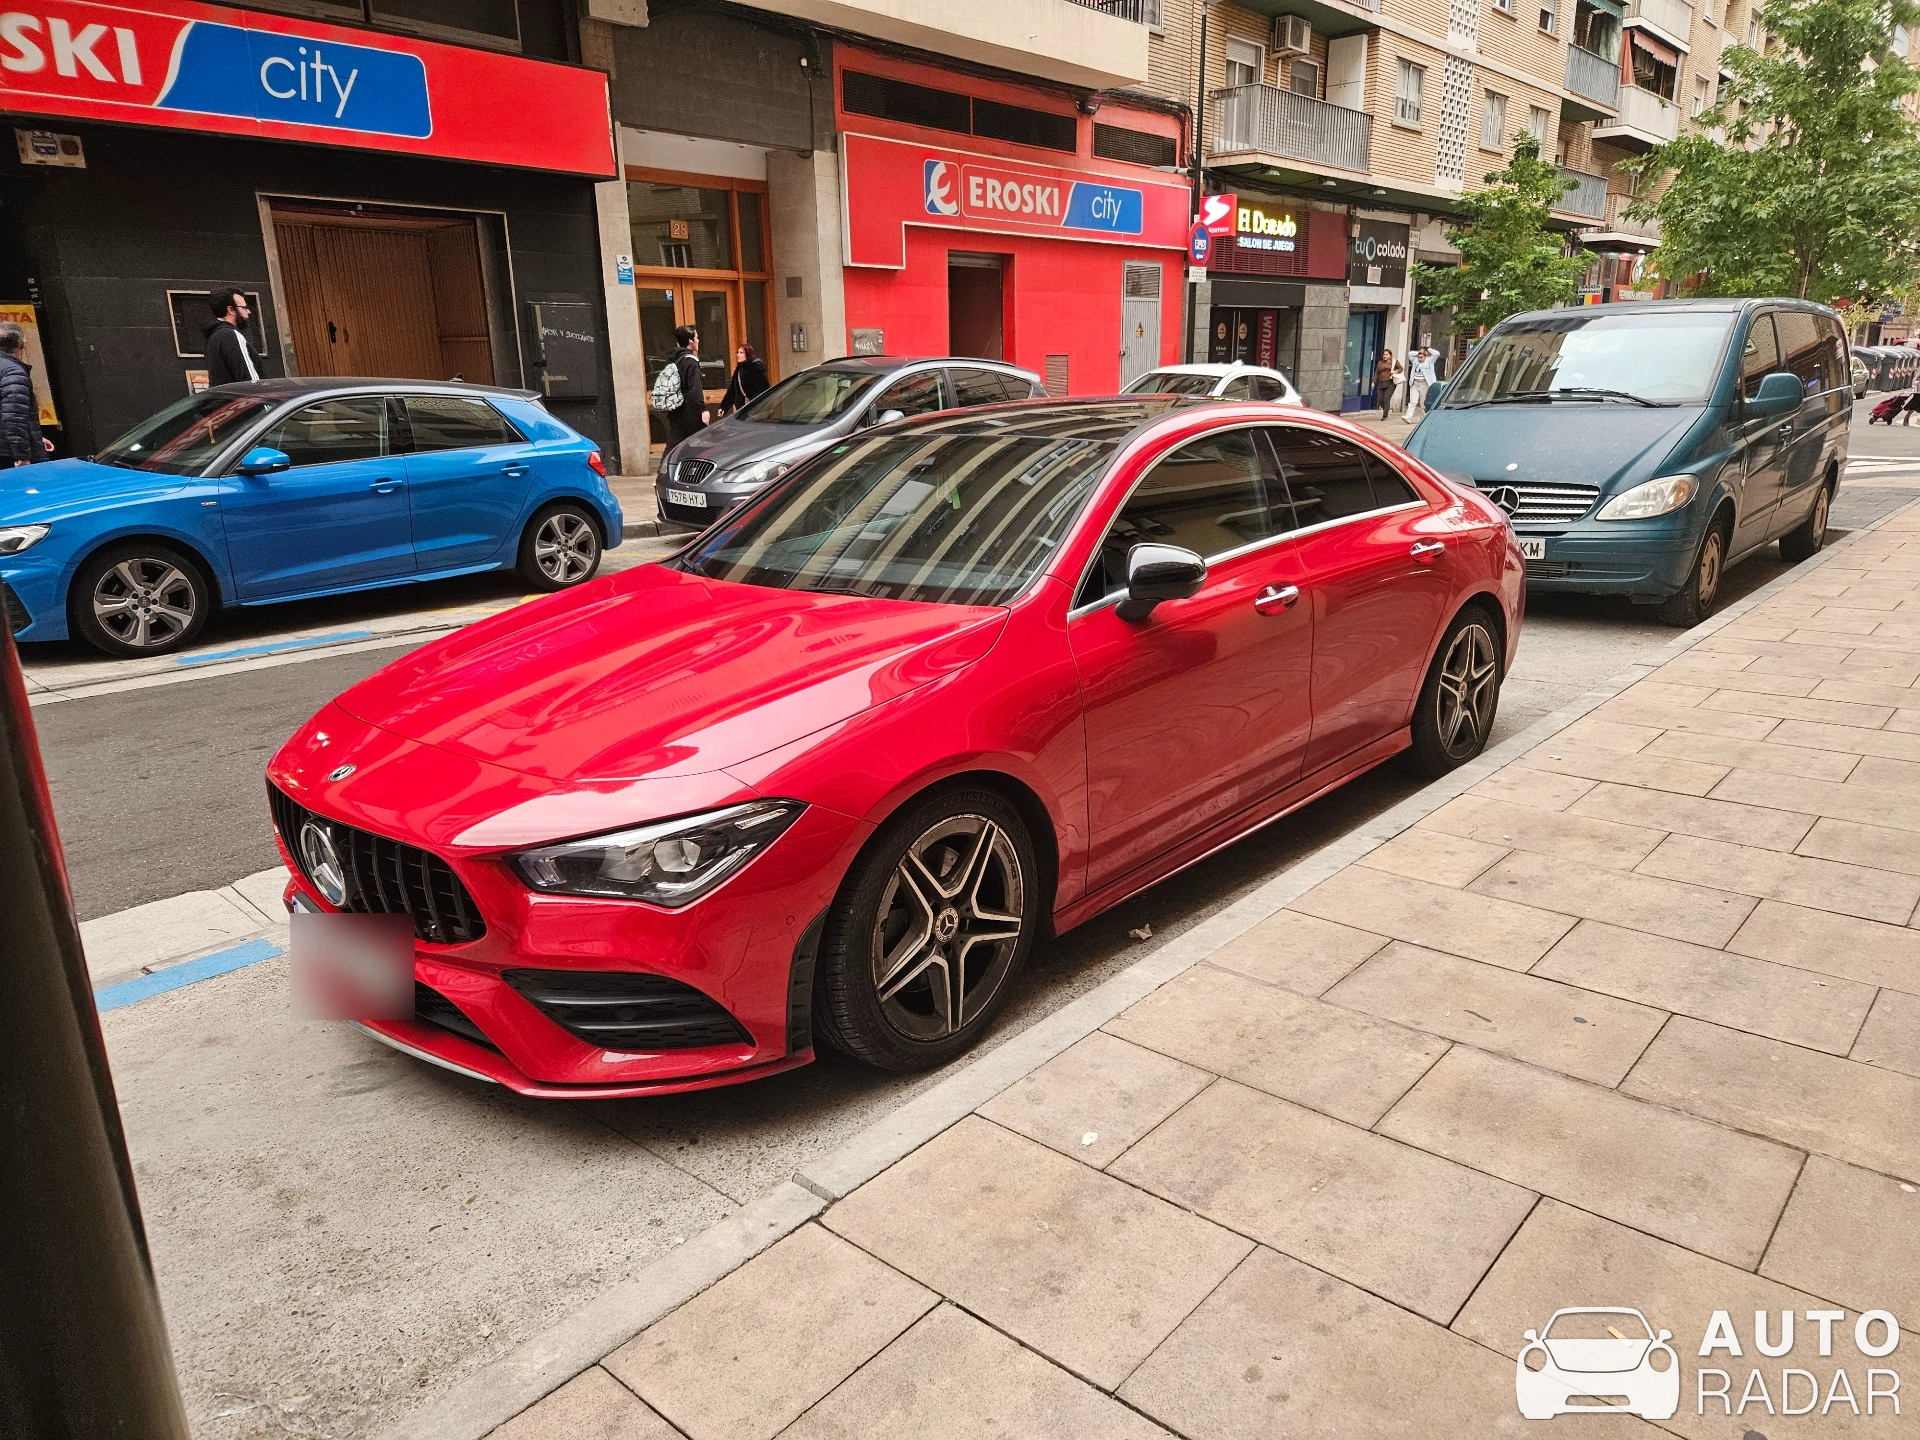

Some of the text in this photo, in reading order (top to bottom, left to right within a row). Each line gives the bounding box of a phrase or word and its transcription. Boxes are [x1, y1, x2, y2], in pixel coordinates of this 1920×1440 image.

[260, 47, 358, 119] city
[969, 176, 1122, 227] EROSKI city
